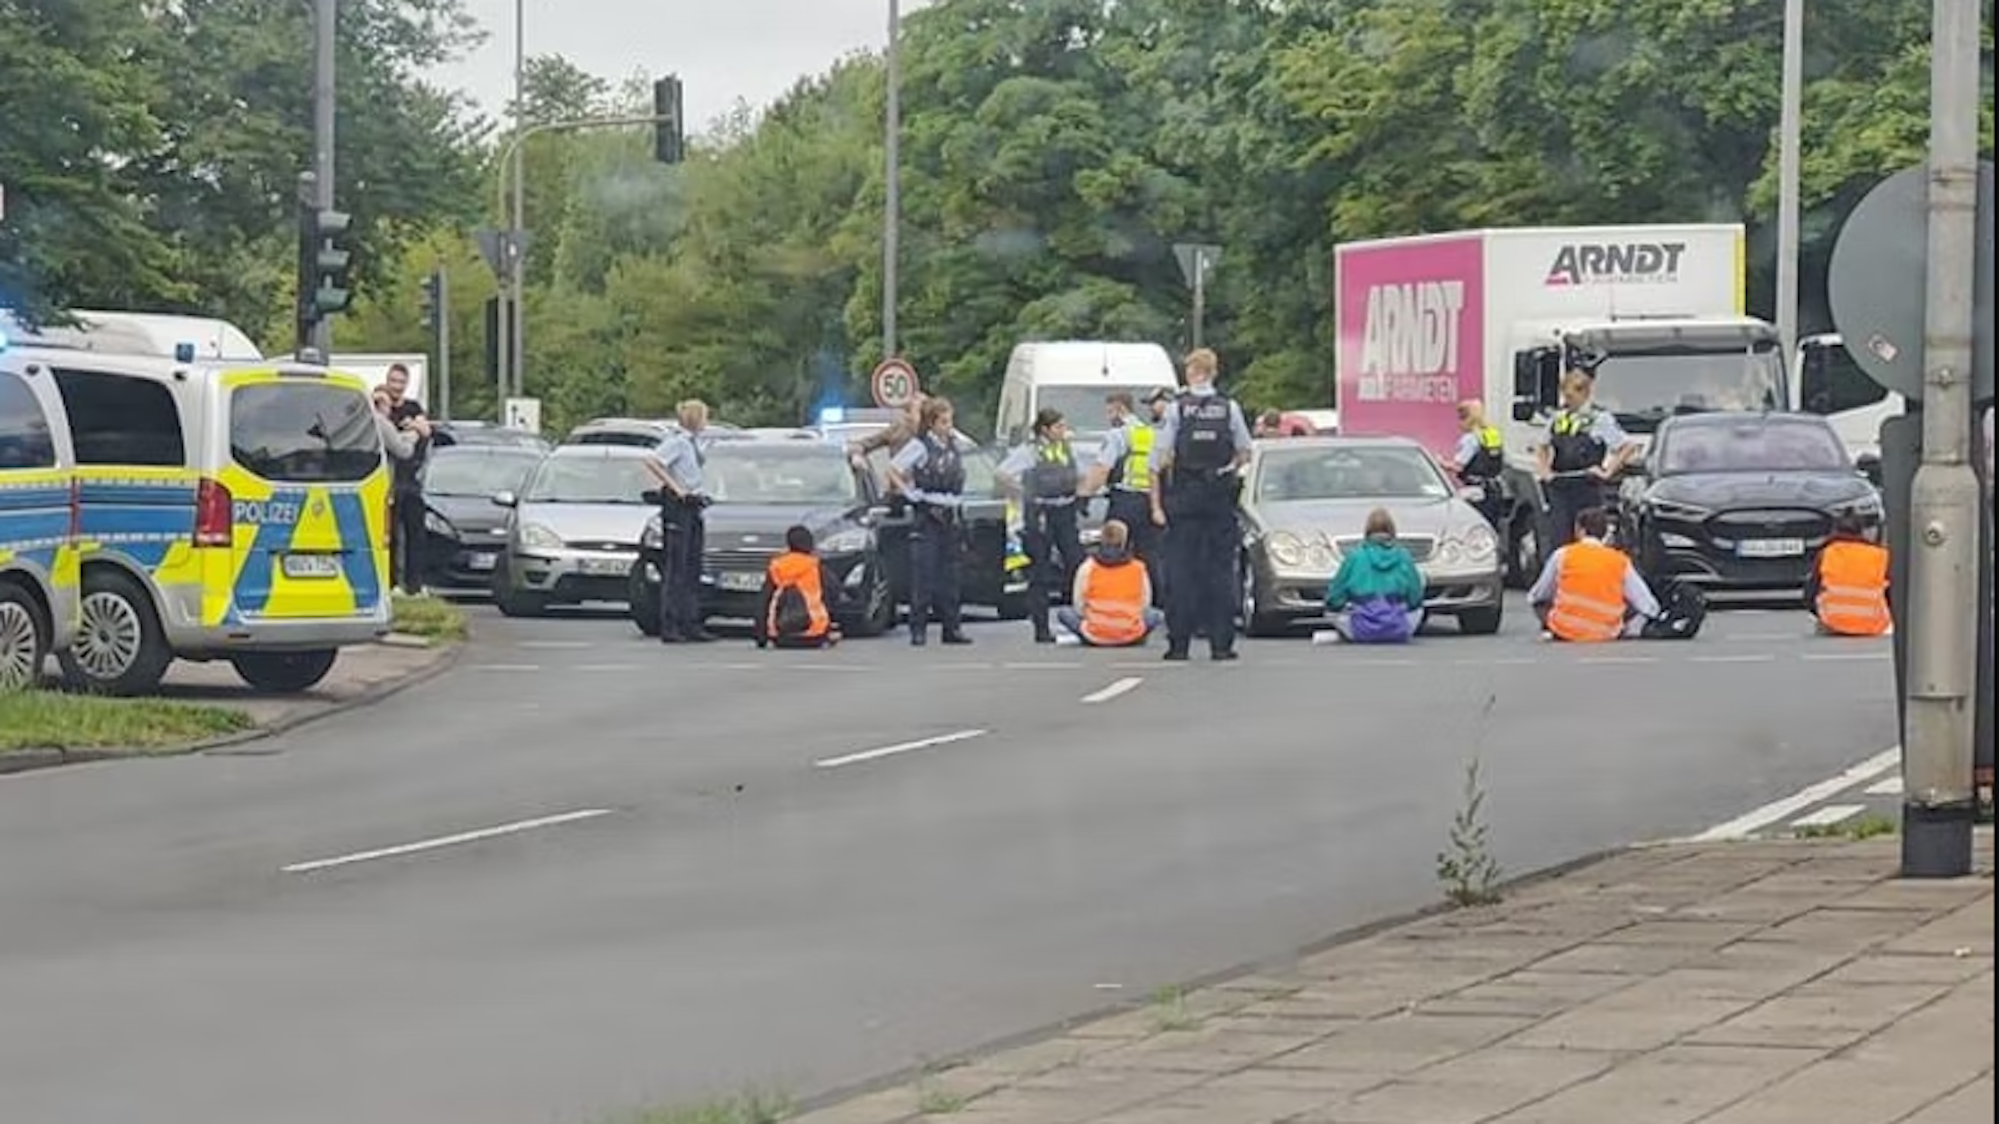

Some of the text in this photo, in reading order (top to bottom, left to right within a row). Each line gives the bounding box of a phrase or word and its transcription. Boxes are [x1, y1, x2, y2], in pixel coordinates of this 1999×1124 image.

[1545, 243, 1685, 285] ARNDT
[1359, 280, 1464, 400] ARNDT
[885, 374, 907, 399] 50
[233, 501, 299, 524] POLIZEI
